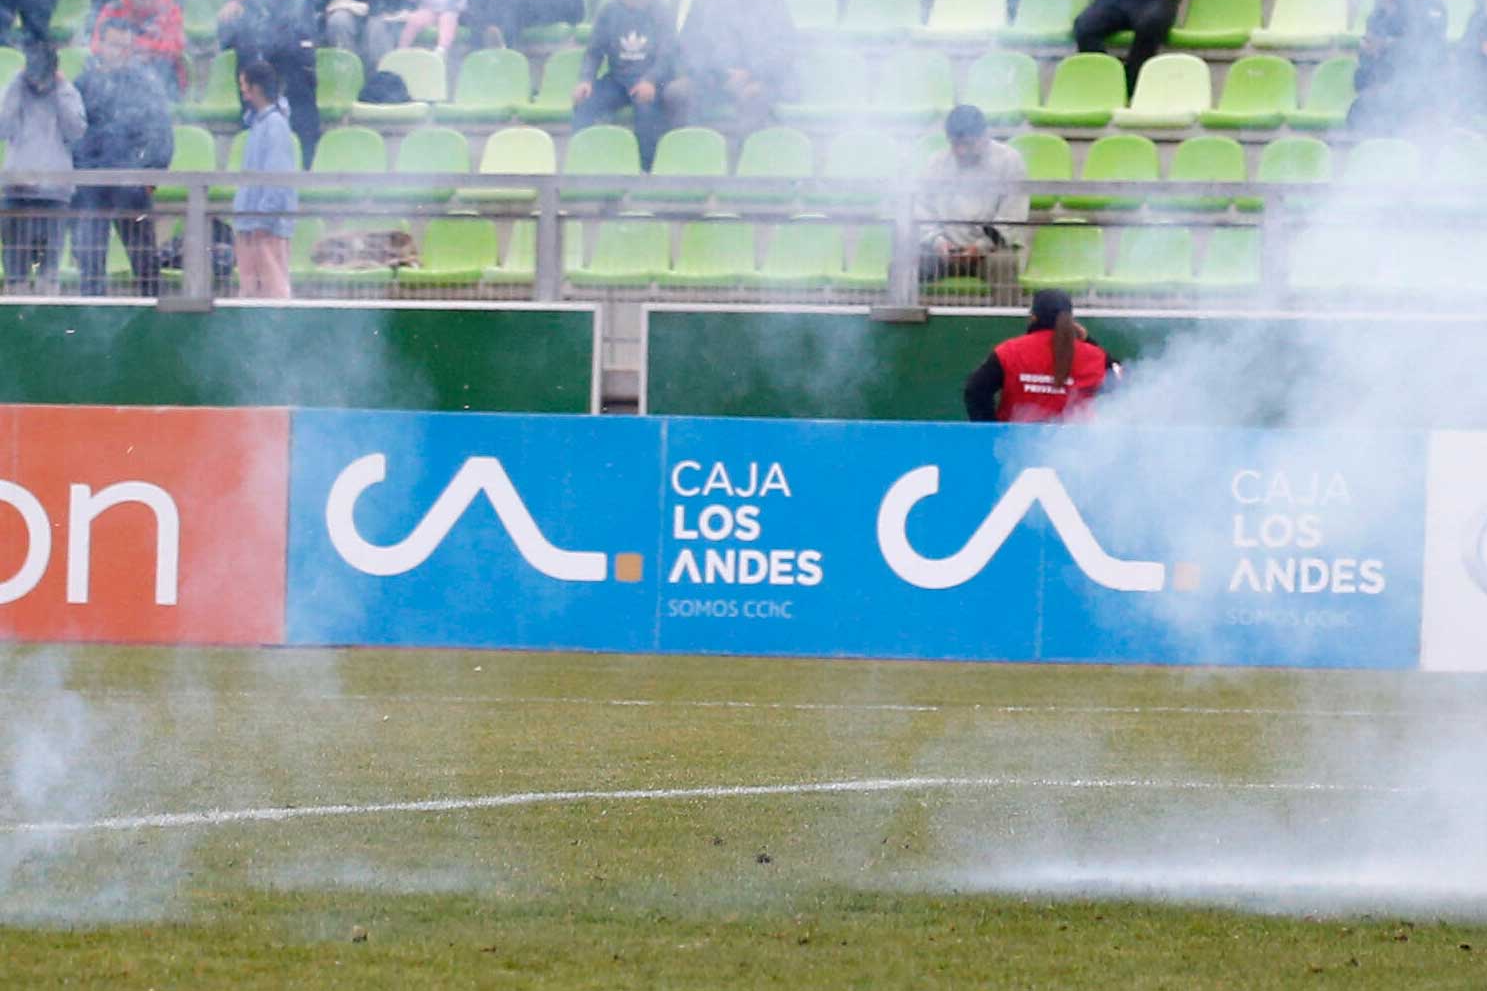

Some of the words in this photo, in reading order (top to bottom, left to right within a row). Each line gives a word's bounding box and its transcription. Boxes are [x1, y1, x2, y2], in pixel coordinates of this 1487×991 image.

[671, 459, 792, 498] CAJA
[1231, 468, 1352, 507] CAJA
[673, 504, 761, 542] LOS
[1231, 512, 1323, 549] LOS
[667, 547, 824, 586] ANDES
[1228, 557, 1386, 595] ANDES
[667, 598, 739, 618] SOMOS
